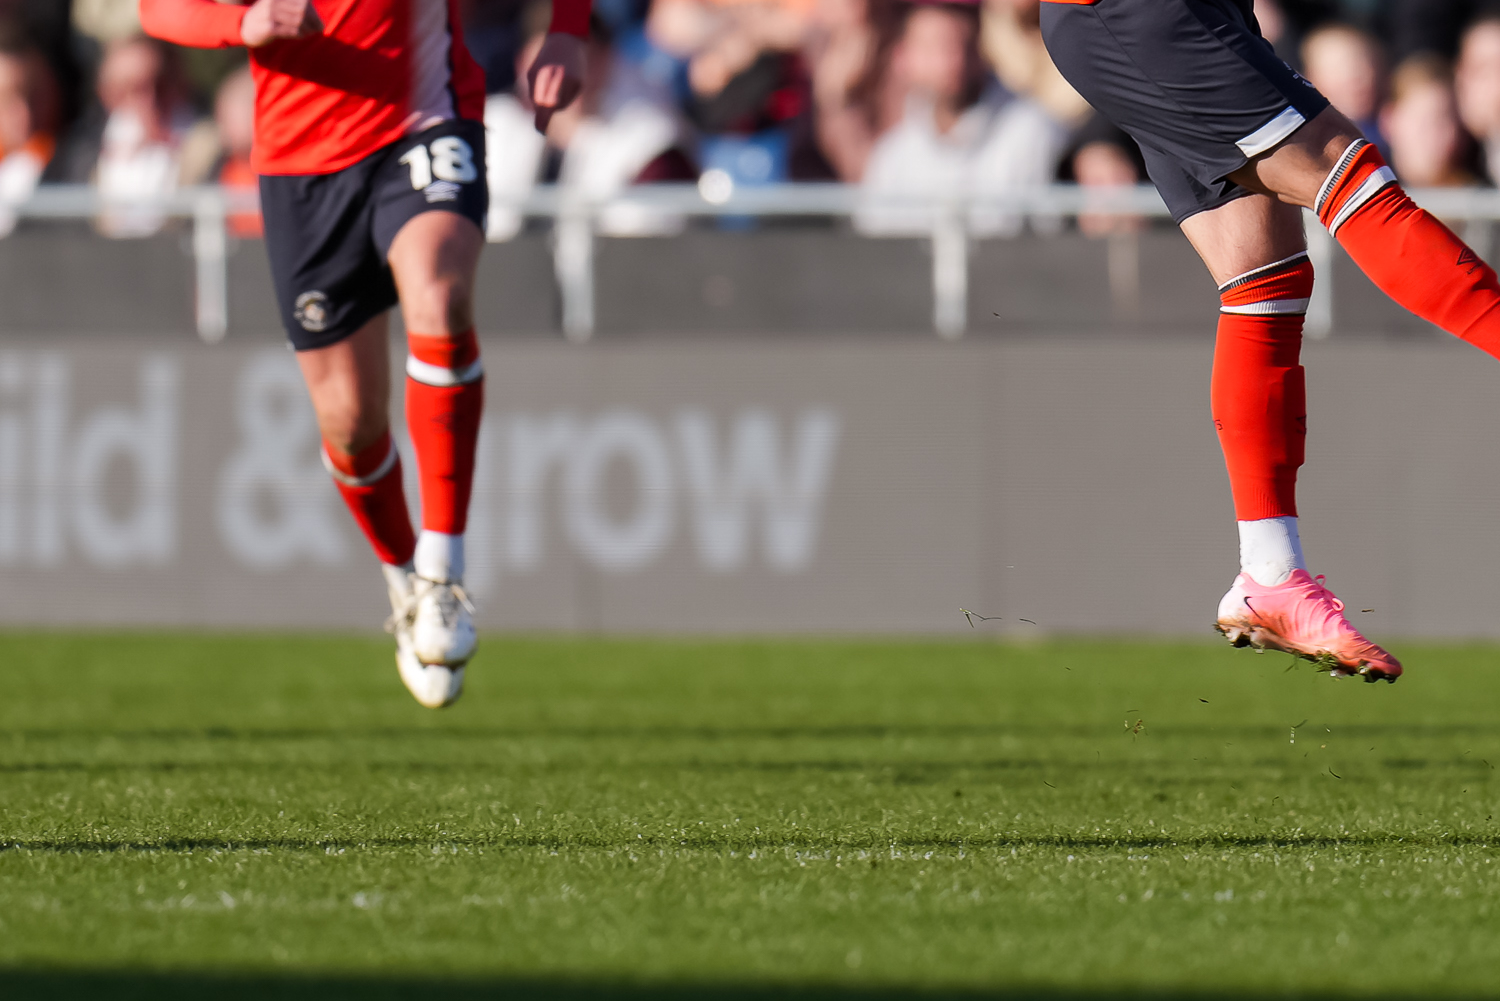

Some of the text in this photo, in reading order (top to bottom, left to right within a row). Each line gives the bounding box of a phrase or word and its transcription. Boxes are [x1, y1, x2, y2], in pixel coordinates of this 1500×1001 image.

[398, 135, 478, 191] 18
[214, 347, 350, 572] &
[398, 402, 840, 603] row
